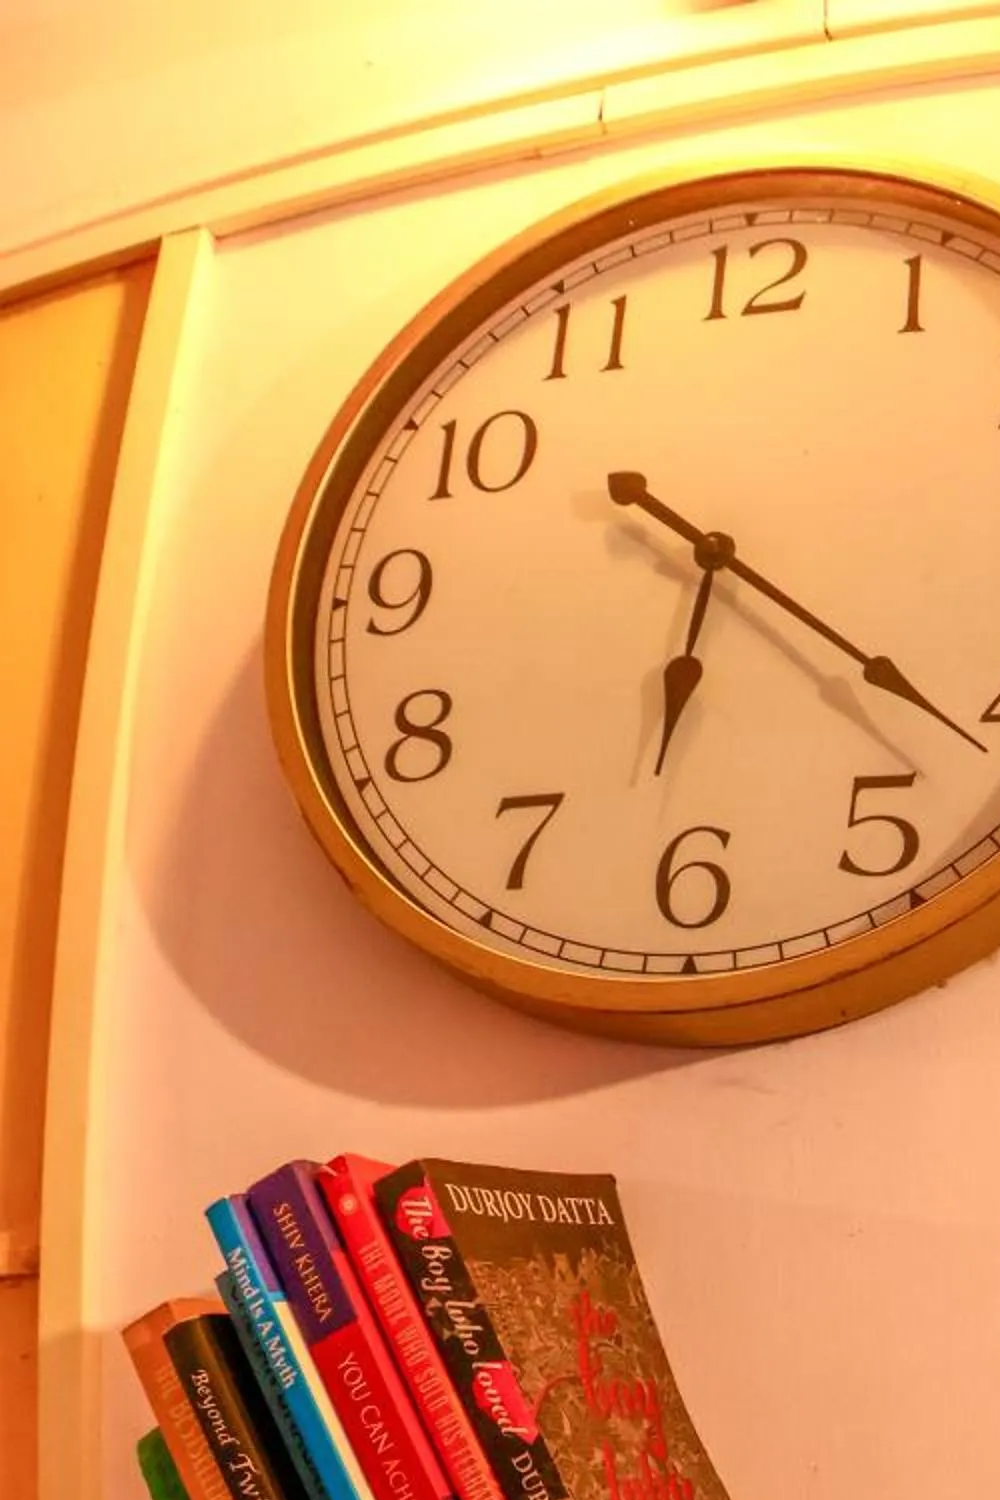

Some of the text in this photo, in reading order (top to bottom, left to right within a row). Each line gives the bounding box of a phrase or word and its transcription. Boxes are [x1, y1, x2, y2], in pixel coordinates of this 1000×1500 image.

[705, 237, 809, 320] 12
[898, 255, 925, 334] 1
[544, 295, 627, 380] 11
[428, 410, 538, 500] 10
[366, 549, 433, 637] 9
[384, 689, 454, 783] 8
[494, 792, 566, 891] 7
[837, 772, 922, 878] 5
[654, 826, 731, 929] 6
[401, 1195, 432, 1241] The
[445, 1183, 616, 1226] DURJOY DATTA
[228, 1247, 258, 1300] Mind
[273, 1203, 334, 1324] SHIV KHERA
[257, 1320, 274, 1337] A
[264, 1338, 299, 1390] Myth
[192, 1369, 240, 1448] Beyond
[338, 1352, 371, 1402] YOU
[360, 1403, 395, 1455] CAN
